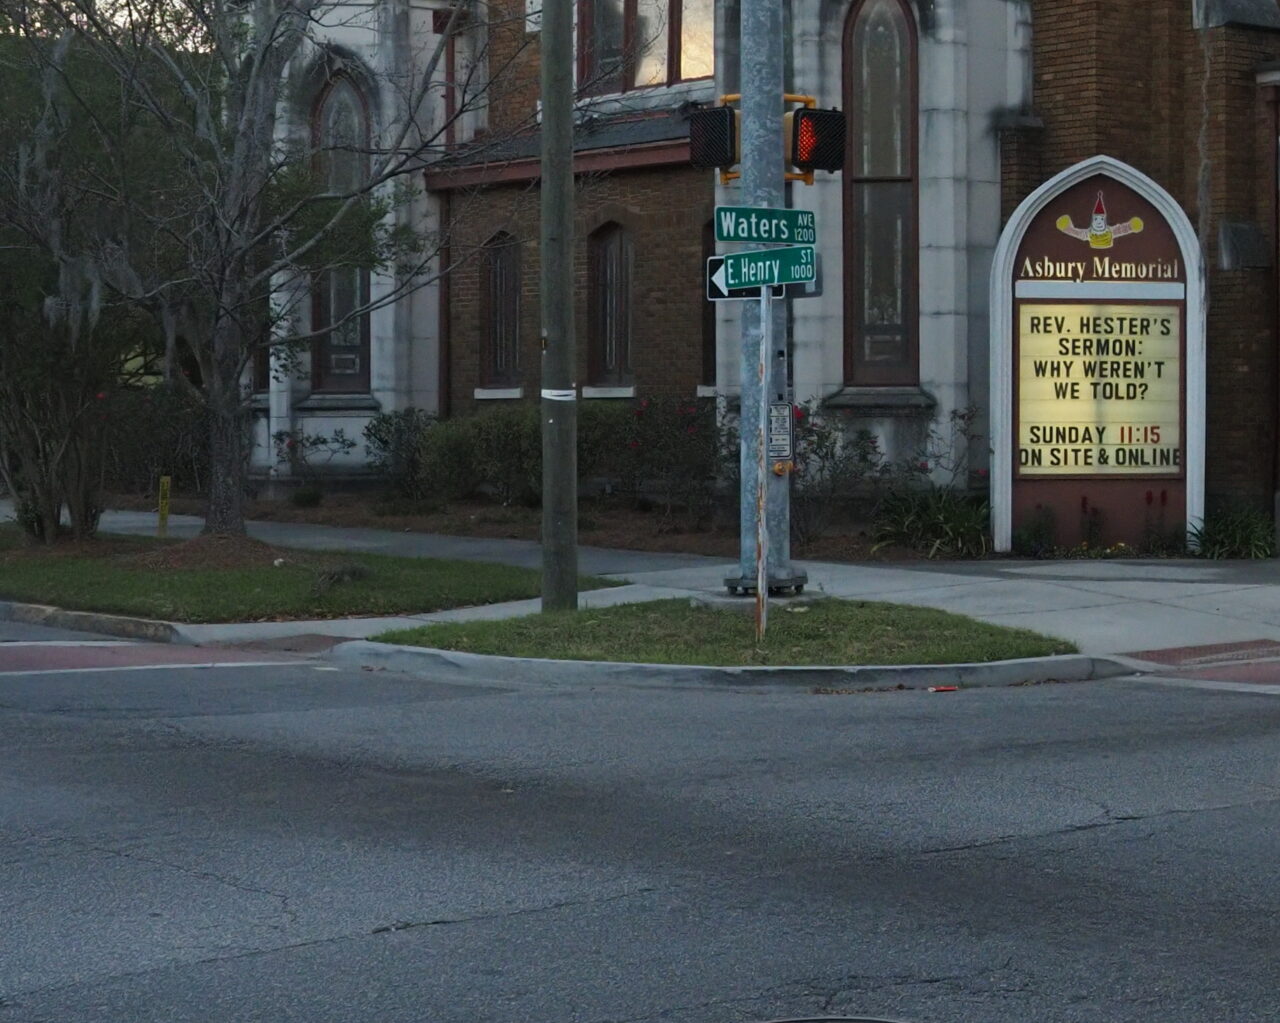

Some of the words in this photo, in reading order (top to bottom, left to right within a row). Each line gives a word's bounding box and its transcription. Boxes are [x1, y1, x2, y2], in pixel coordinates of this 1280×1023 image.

[720, 212, 789, 238] Waters
[798, 214, 813, 226] AVE
[794, 229, 814, 241] 1200
[801, 249, 812, 263] ST
[727, 259, 739, 284] E.
[741, 258, 780, 284] Henry
[791, 265, 813, 279] 1000
[1020, 256, 1086, 282] Asbury
[1093, 256, 1178, 279] Memorial
[1030, 316, 1071, 334] REV.
[1080, 316, 1171, 336] HESTER'S
[1058, 338, 1143, 356] SERMON:
[1033, 360, 1074, 378] WHY
[1083, 360, 1165, 379] WEREN'T
[1054, 382, 1080, 399] WE
[1090, 382, 1149, 400] TOLD?
[1029, 426, 1106, 444] SUNDAY
[1120, 426, 1161, 444] 11:15
[1019, 448, 1042, 466] ON
[1050, 448, 1093, 466] SITE
[1097, 448, 1110, 465] &
[1115, 448, 1181, 466] ONLINE
